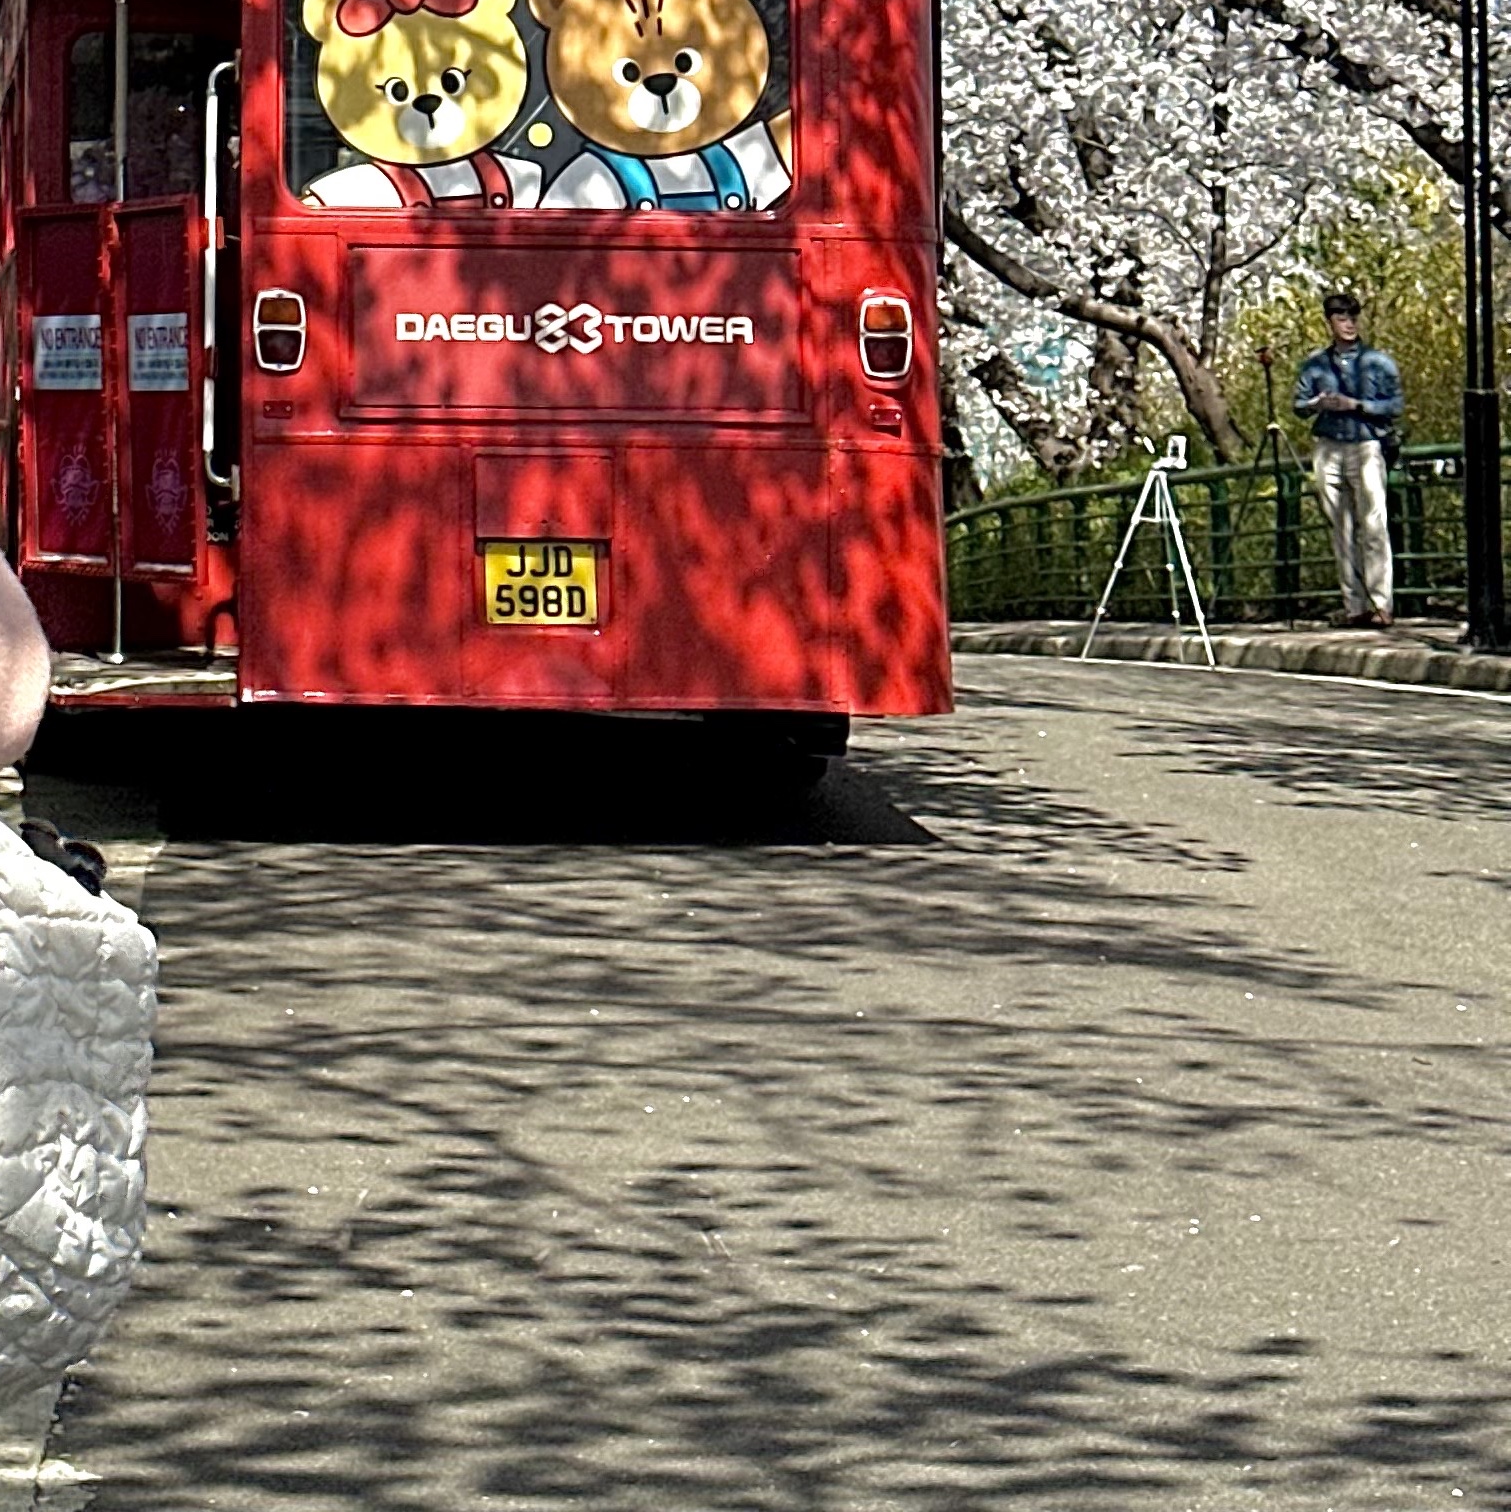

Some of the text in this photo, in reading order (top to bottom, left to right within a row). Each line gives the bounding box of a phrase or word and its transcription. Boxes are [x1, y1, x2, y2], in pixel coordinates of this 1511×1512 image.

[40, 326, 101, 350] NO ENTRANCE
[134, 327, 146, 350] NO
[395, 312, 532, 342] DAEGU
[603, 315, 755, 344] TOWER
[505, 544, 574, 578] JJD
[494, 584, 587, 619] 598D
